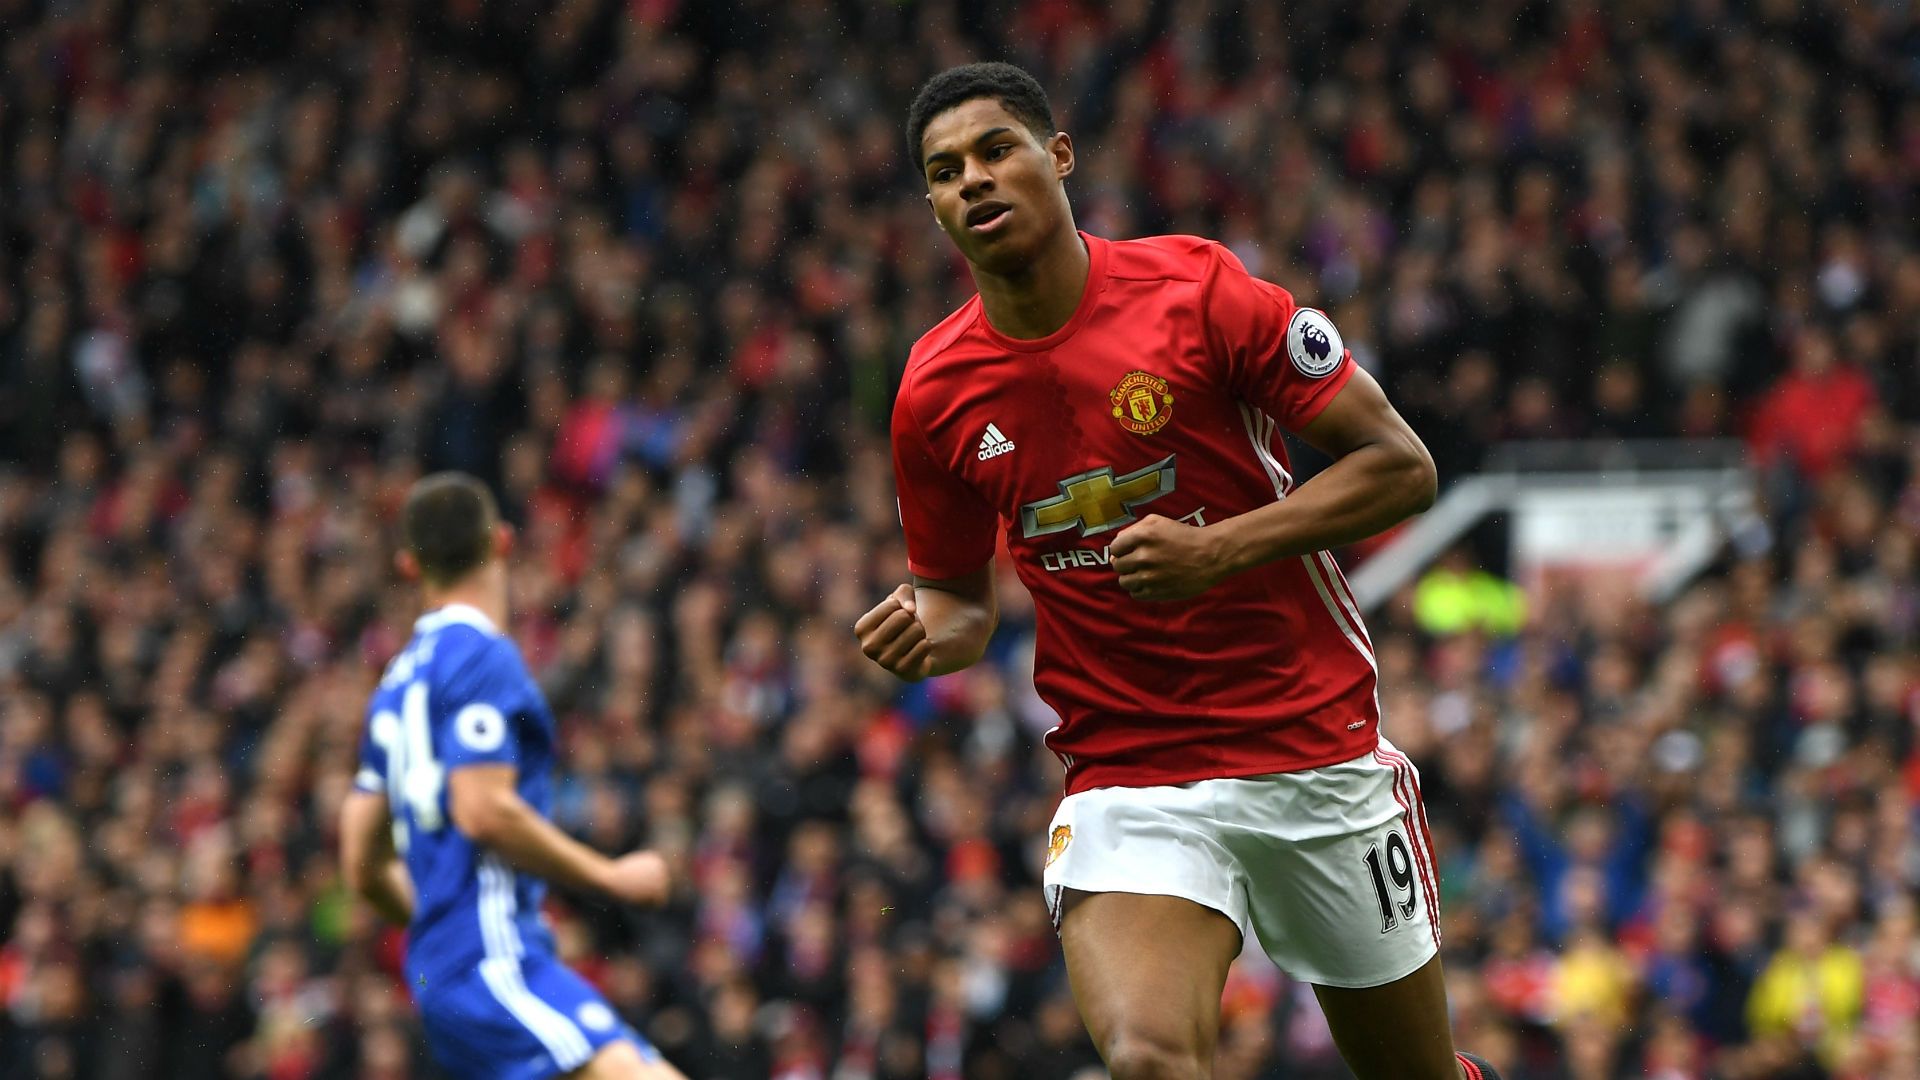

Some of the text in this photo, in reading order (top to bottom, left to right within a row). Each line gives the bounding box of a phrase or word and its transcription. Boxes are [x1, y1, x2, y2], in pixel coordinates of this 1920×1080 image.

[1115, 375, 1164, 401] MANCHESTER
[1131, 415, 1166, 431] UNITED
[977, 440, 1016, 461] adidas
[1041, 506, 1206, 572] CHEVT
[1363, 830, 1418, 933] 19
